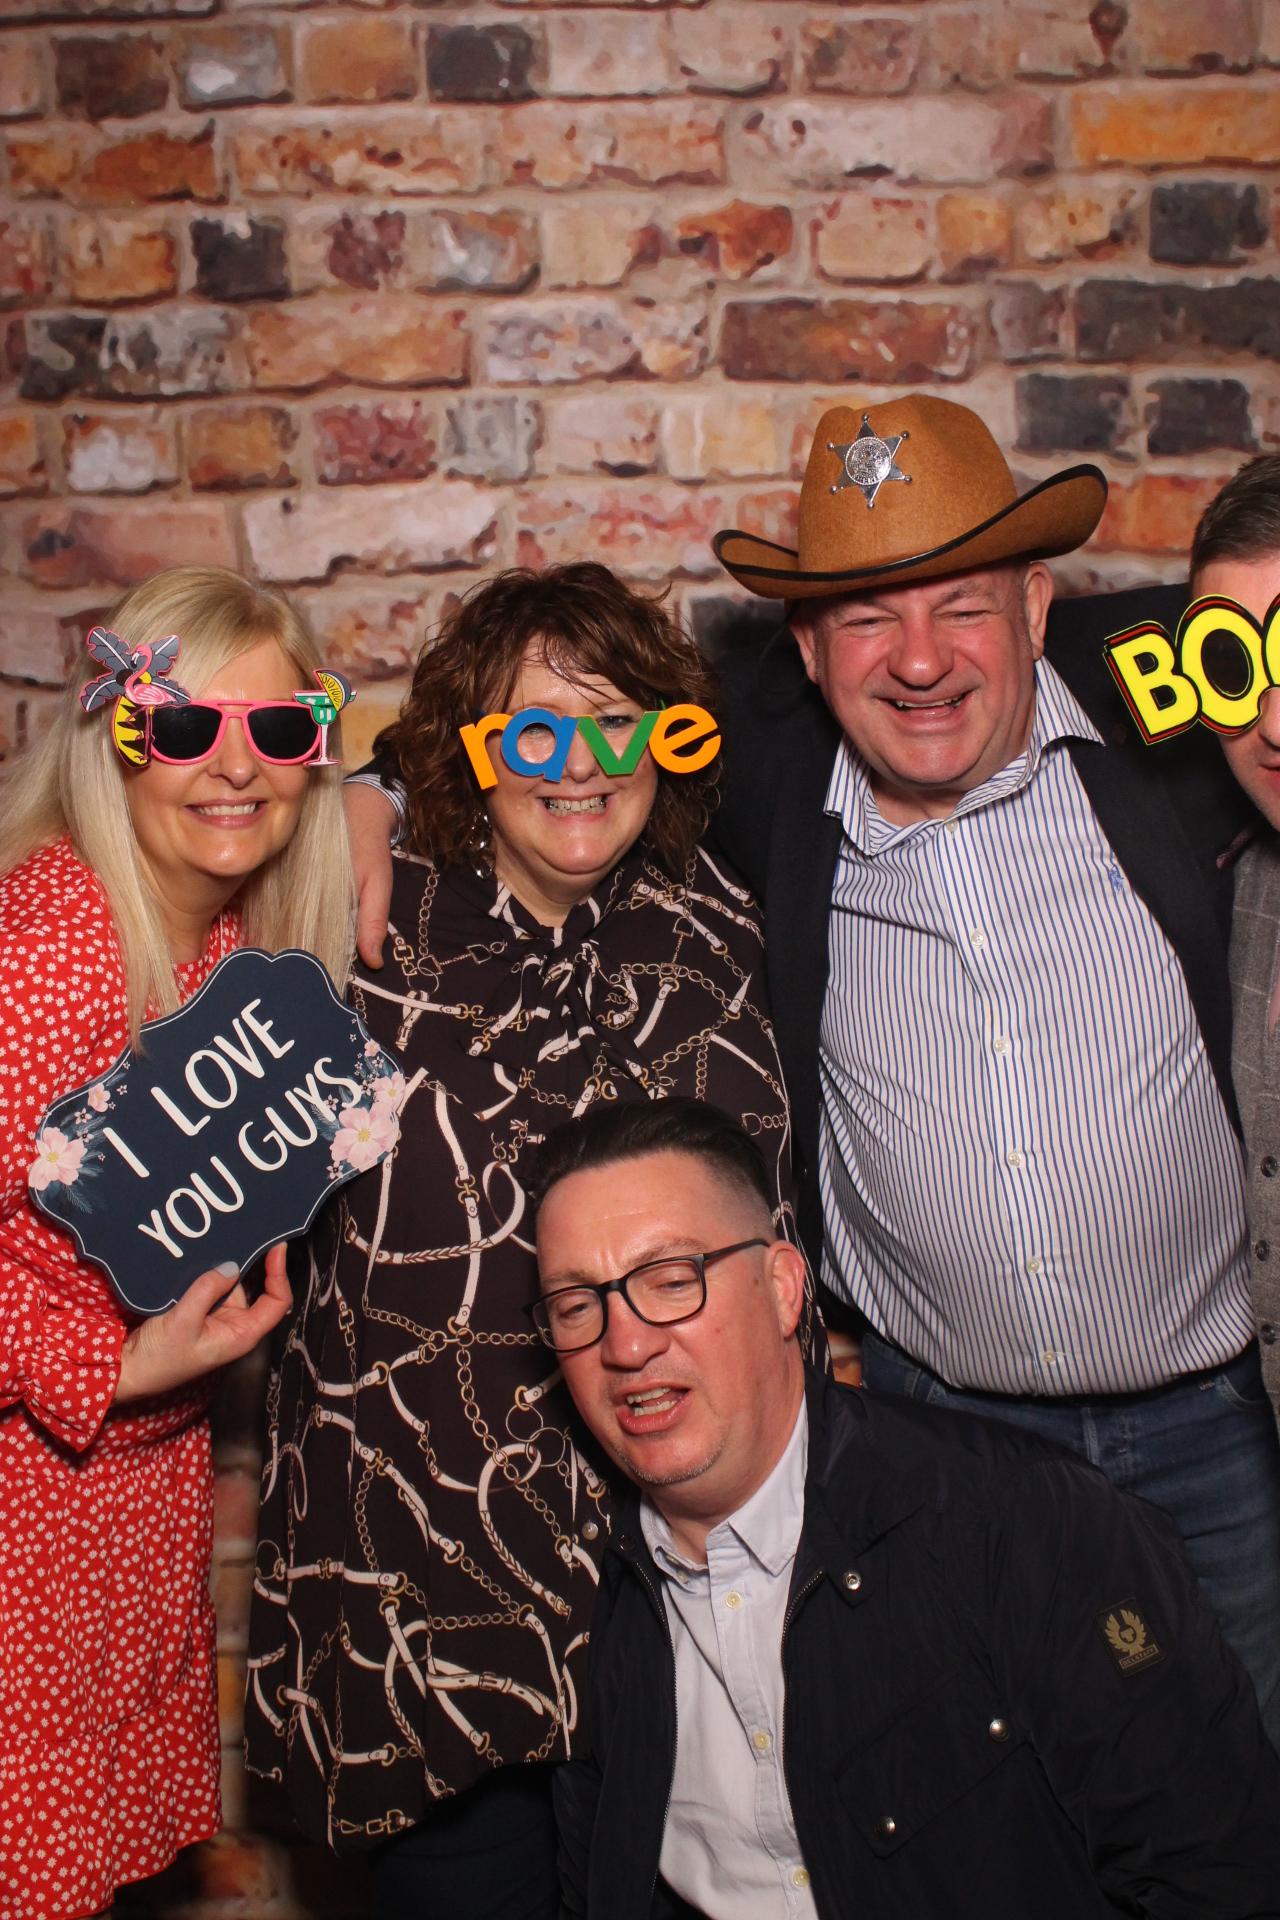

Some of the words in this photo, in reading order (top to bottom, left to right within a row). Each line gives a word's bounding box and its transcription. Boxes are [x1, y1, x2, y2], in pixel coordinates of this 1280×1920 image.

[459, 704, 721, 790] rave
[1103, 594, 1280, 745] BO
[103, 1128, 150, 1178] I
[151, 999, 295, 1136] LOVE
[138, 1156, 245, 1258] YOU
[238, 1057, 362, 1171] GUYS
